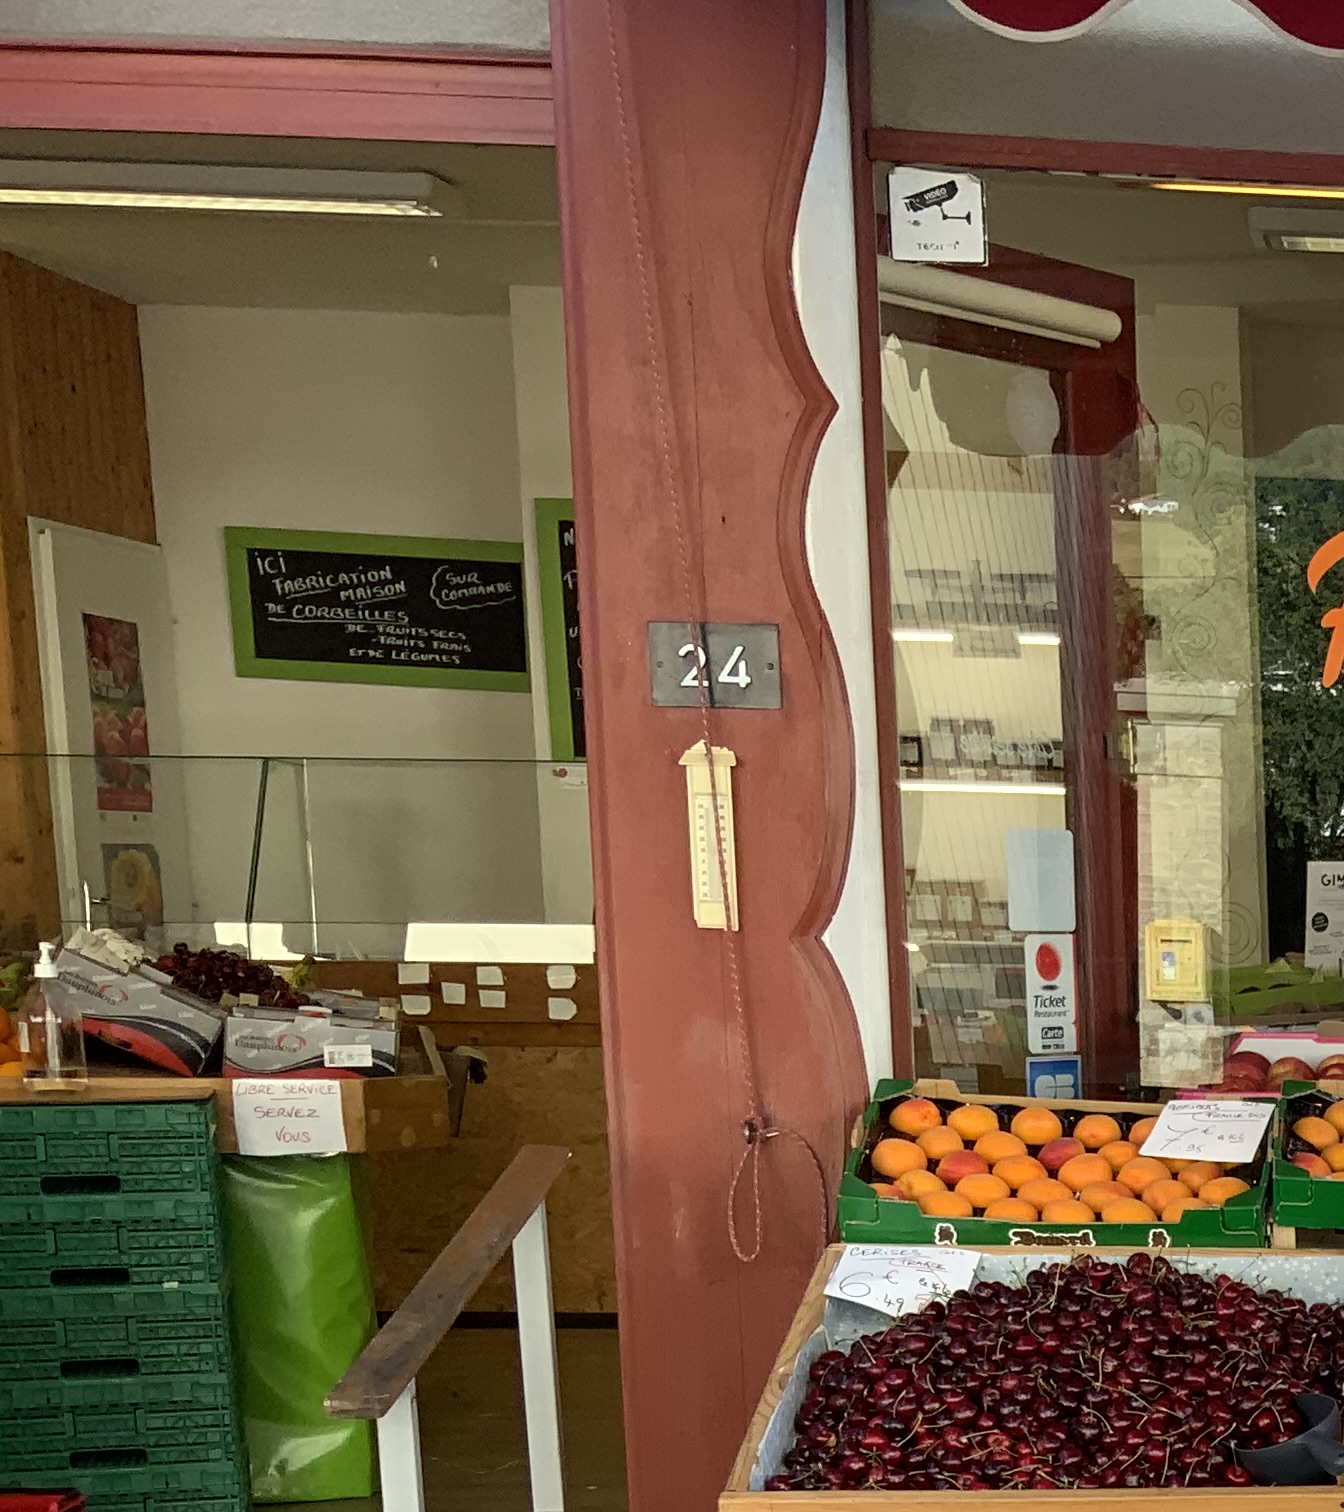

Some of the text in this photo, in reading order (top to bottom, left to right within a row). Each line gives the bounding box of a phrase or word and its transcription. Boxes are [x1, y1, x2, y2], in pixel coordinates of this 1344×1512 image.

[446, 572, 480, 586] SUR
[265, 602, 286, 614] DE
[678, 643, 752, 689] 24
[1034, 995, 1067, 1008] Ticket
[235, 1083, 338, 1096] LIBRE SERVICE
[254, 1106, 320, 1119] SERVEZ
[275, 1125, 311, 1143] VOUS
[849, 1246, 923, 1258] CERISES
[839, 1269, 900, 1298] 6 €
